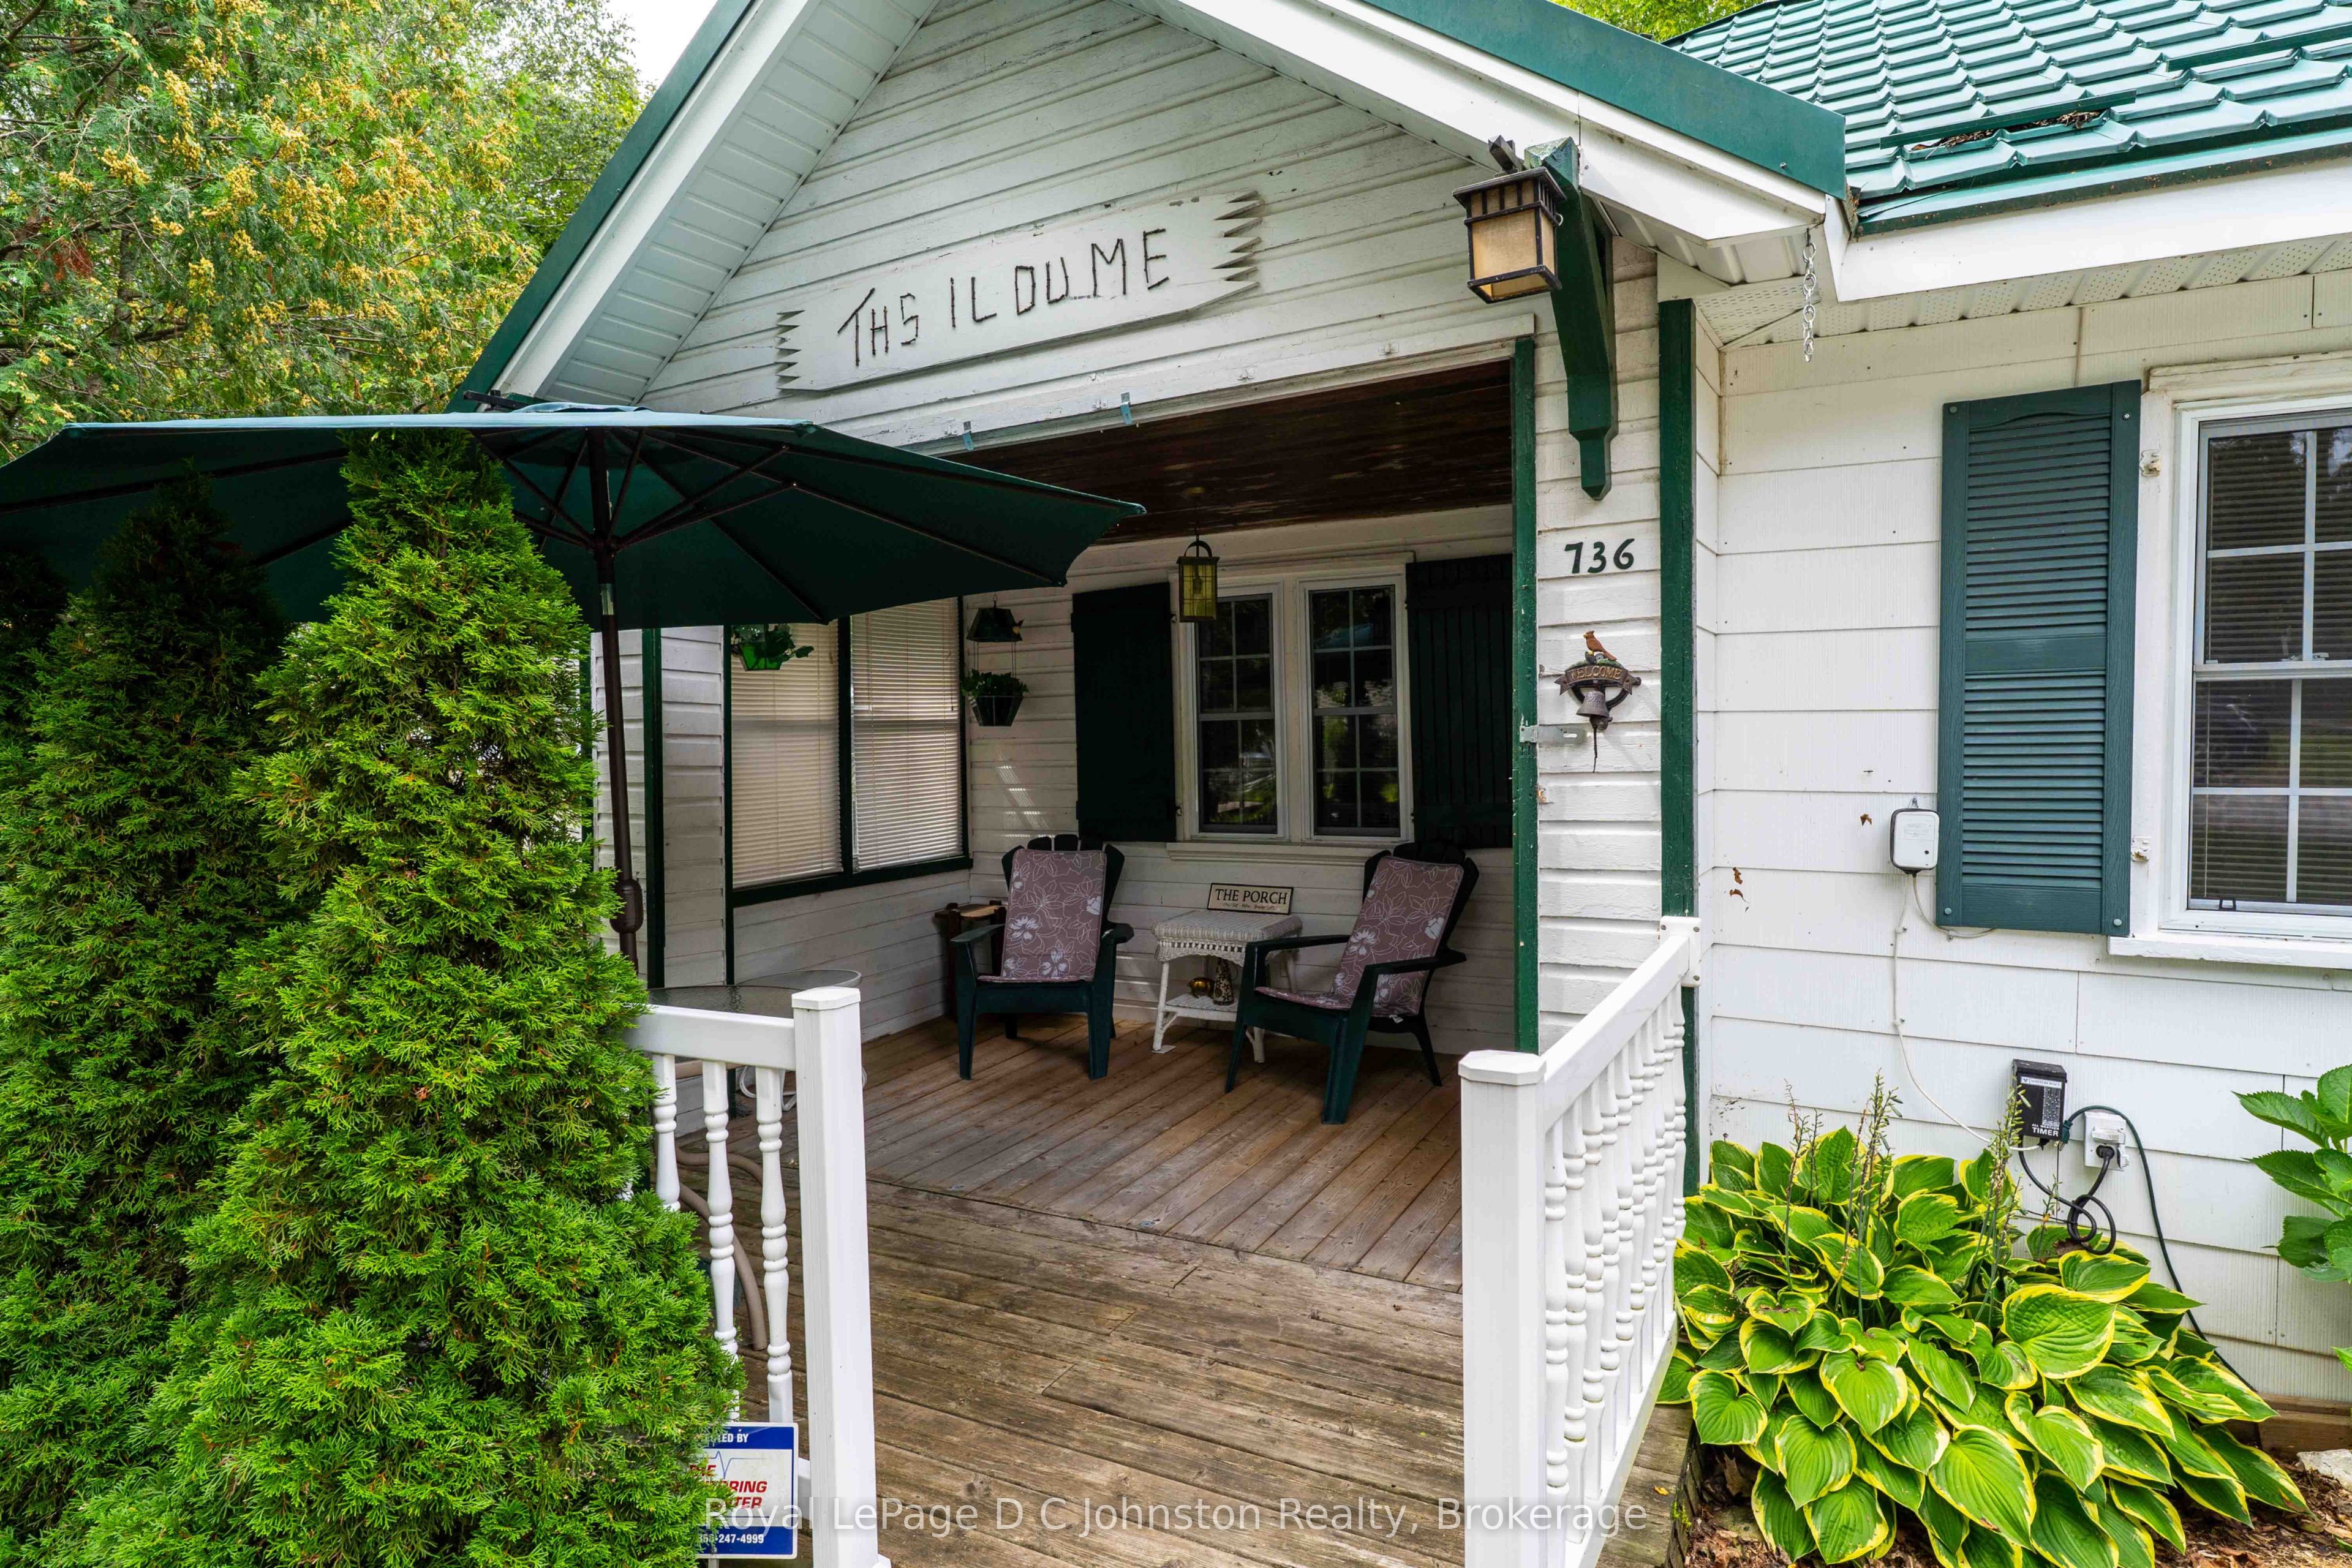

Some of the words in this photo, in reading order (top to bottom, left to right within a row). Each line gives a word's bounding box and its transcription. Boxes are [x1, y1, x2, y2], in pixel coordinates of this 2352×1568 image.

[1564, 538, 1635, 573] 736
[1570, 666, 1622, 680] WELCOME
[1215, 888, 1239, 902] THE
[1243, 890, 1288, 905] PORCH
[2032, 1127, 2059, 1137] TIMER
[736, 1433, 749, 1442] BY
